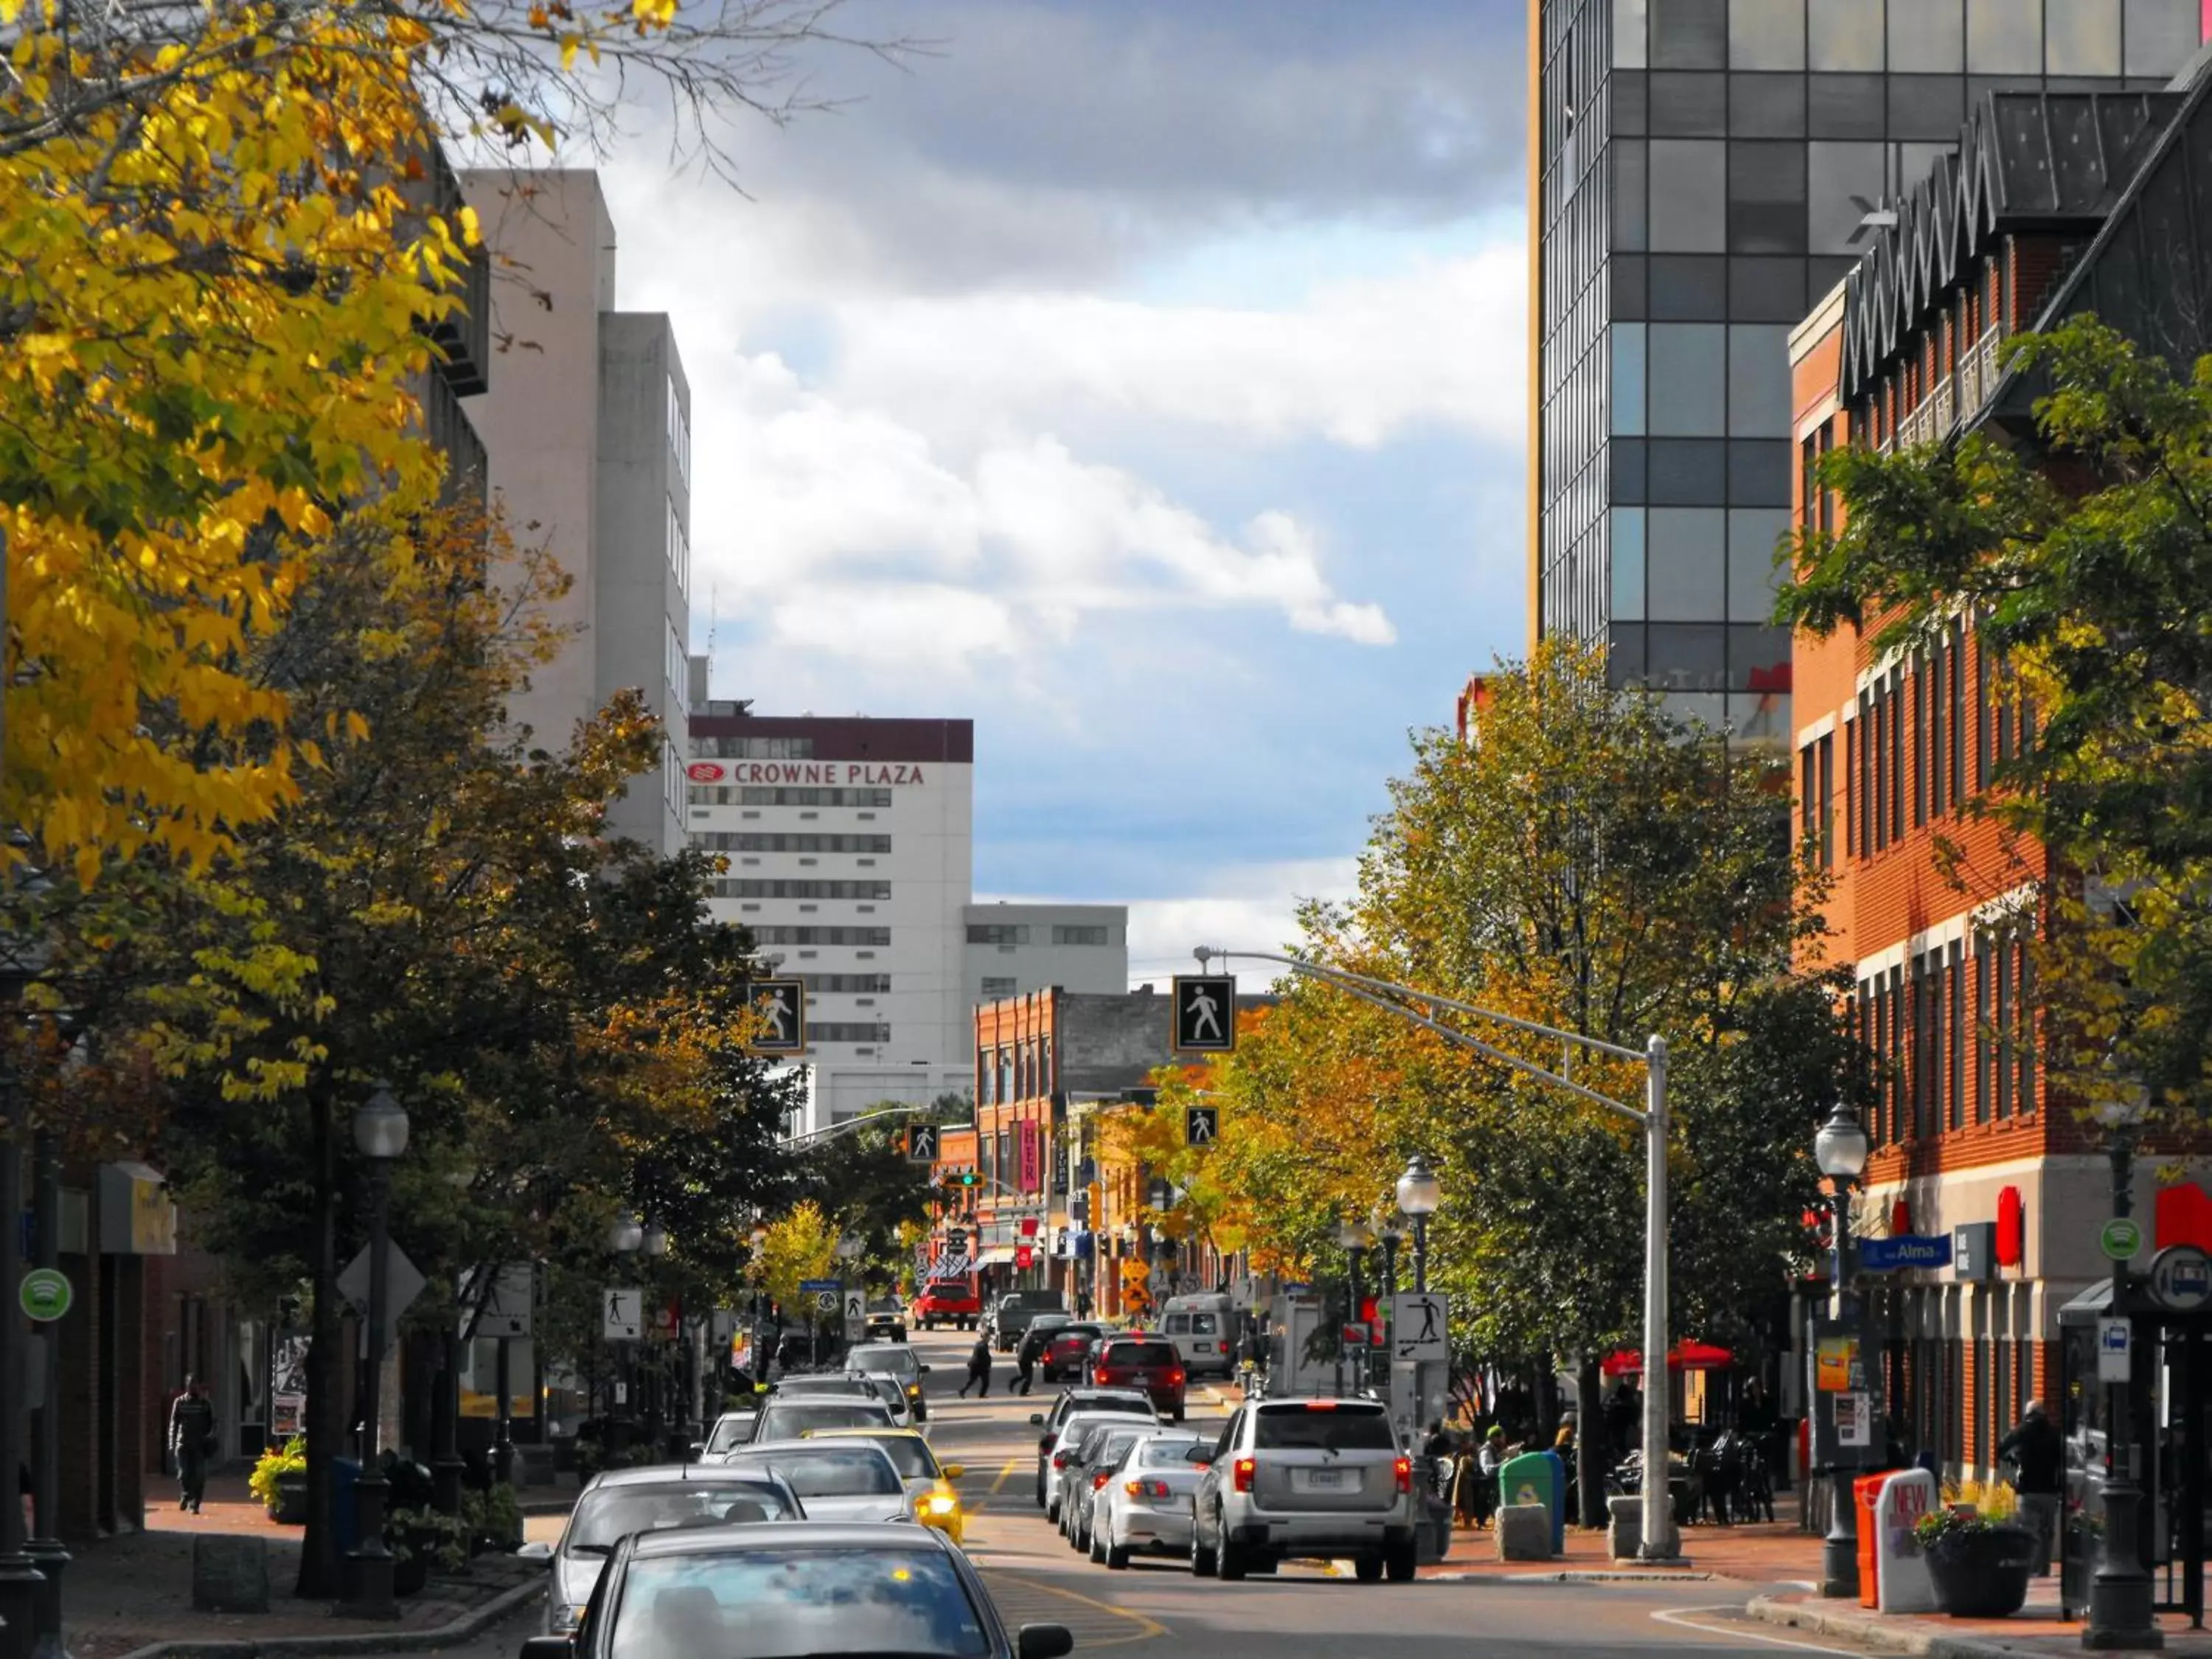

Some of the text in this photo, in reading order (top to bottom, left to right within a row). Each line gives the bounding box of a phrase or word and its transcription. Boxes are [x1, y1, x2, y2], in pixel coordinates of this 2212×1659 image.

[734, 763, 925, 785] CROWNE PLAZA
[1897, 1243, 1935, 1260] Alma
